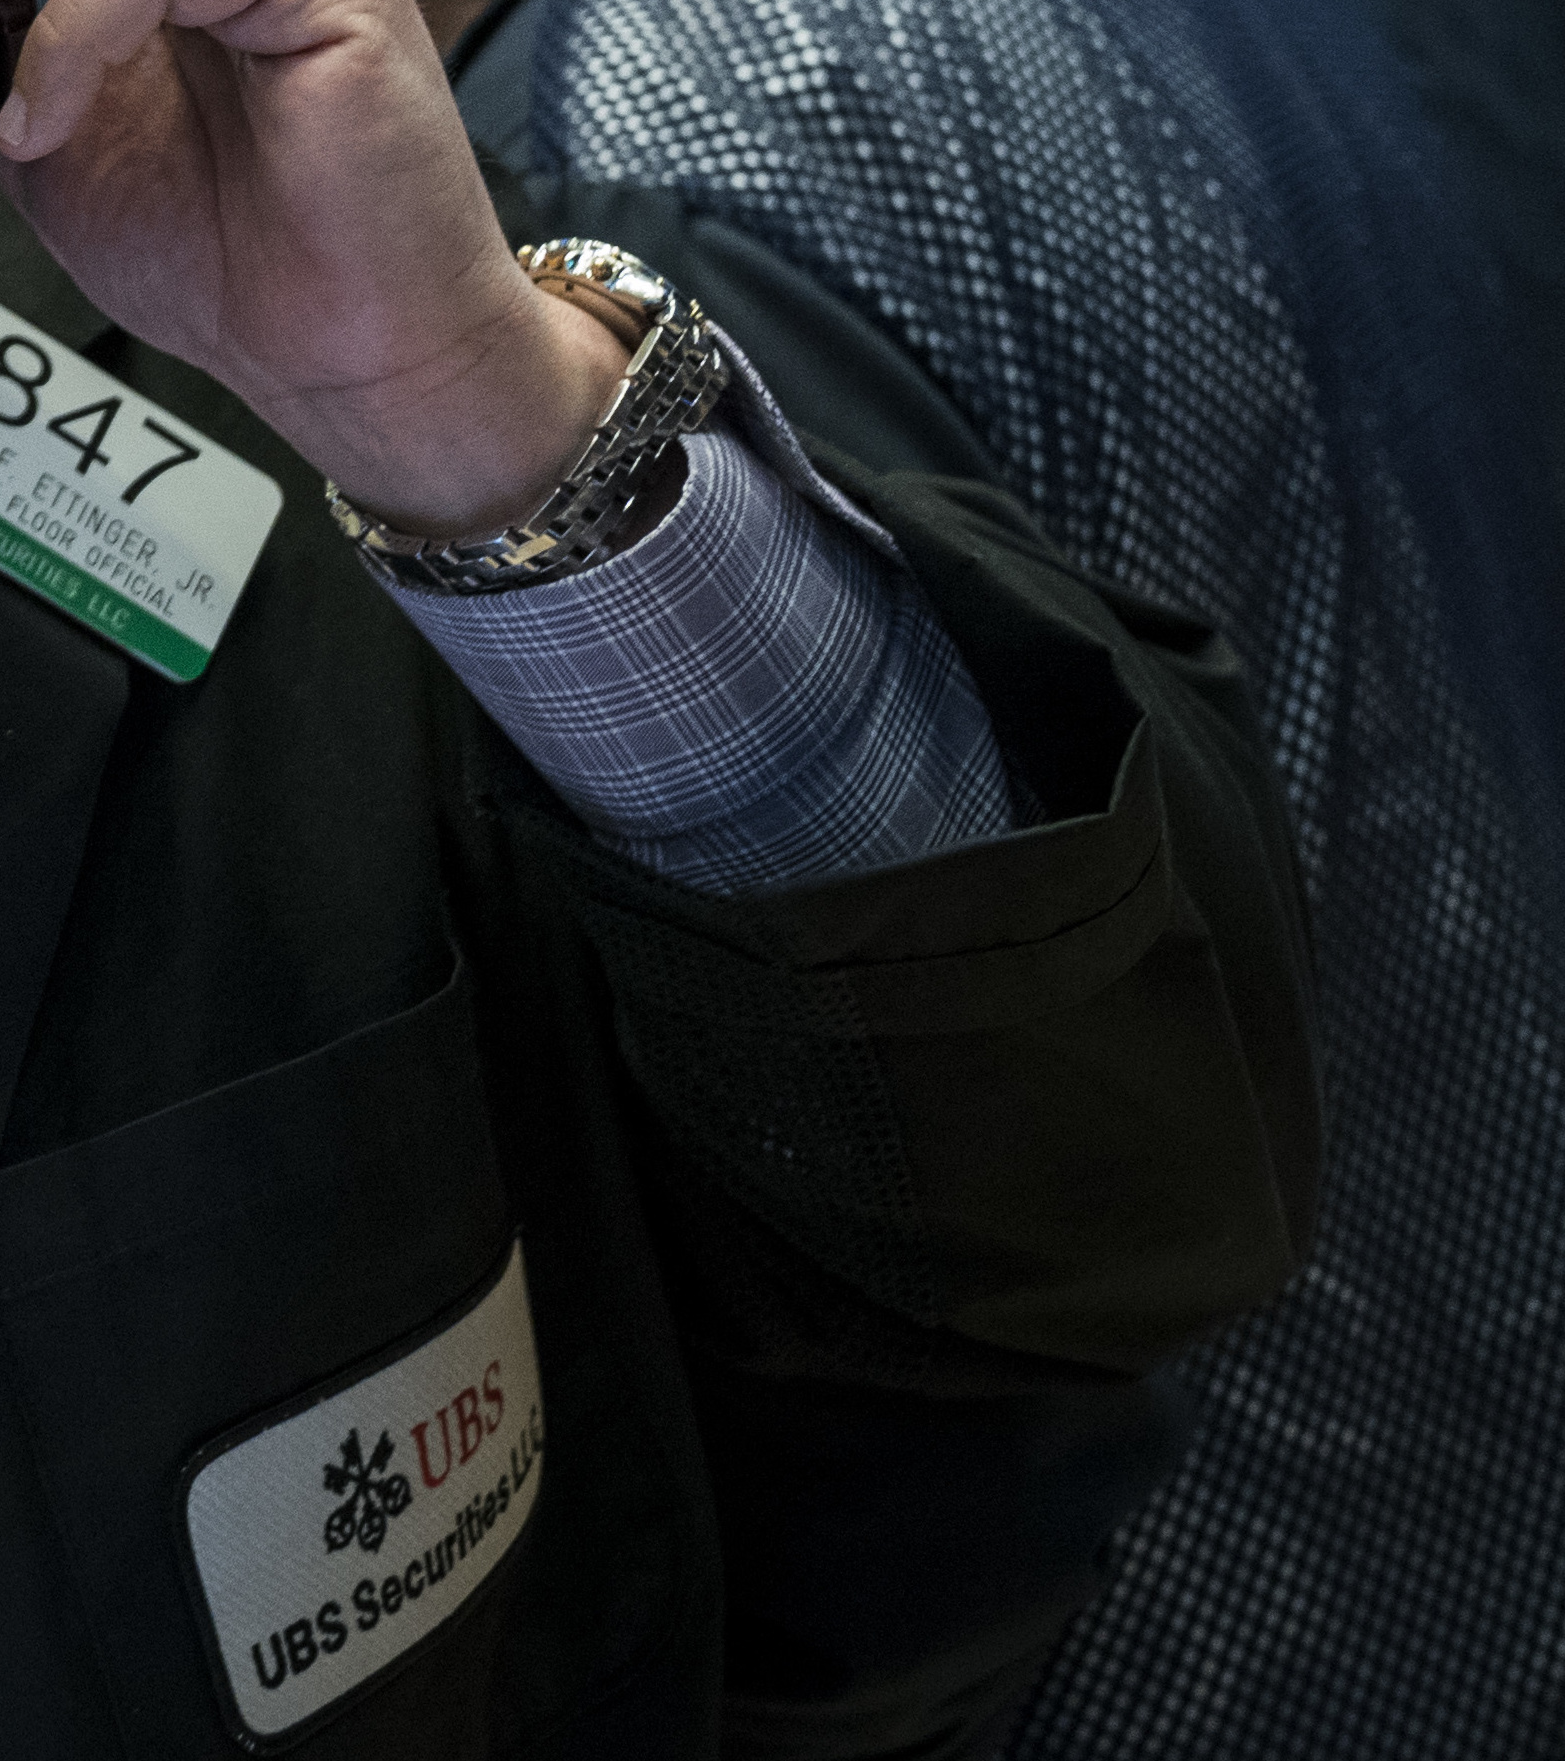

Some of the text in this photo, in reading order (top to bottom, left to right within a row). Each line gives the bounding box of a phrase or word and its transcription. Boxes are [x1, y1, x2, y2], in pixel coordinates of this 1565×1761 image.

[6, 494, 77, 550] FLOOR
[85, 546, 175, 617] OFFICIAL
[87, 593, 131, 631] LLC
[410, 1359, 505, 1488] UBS
[251, 1600, 348, 1690] UBS
[352, 1471, 510, 1632] Securities
